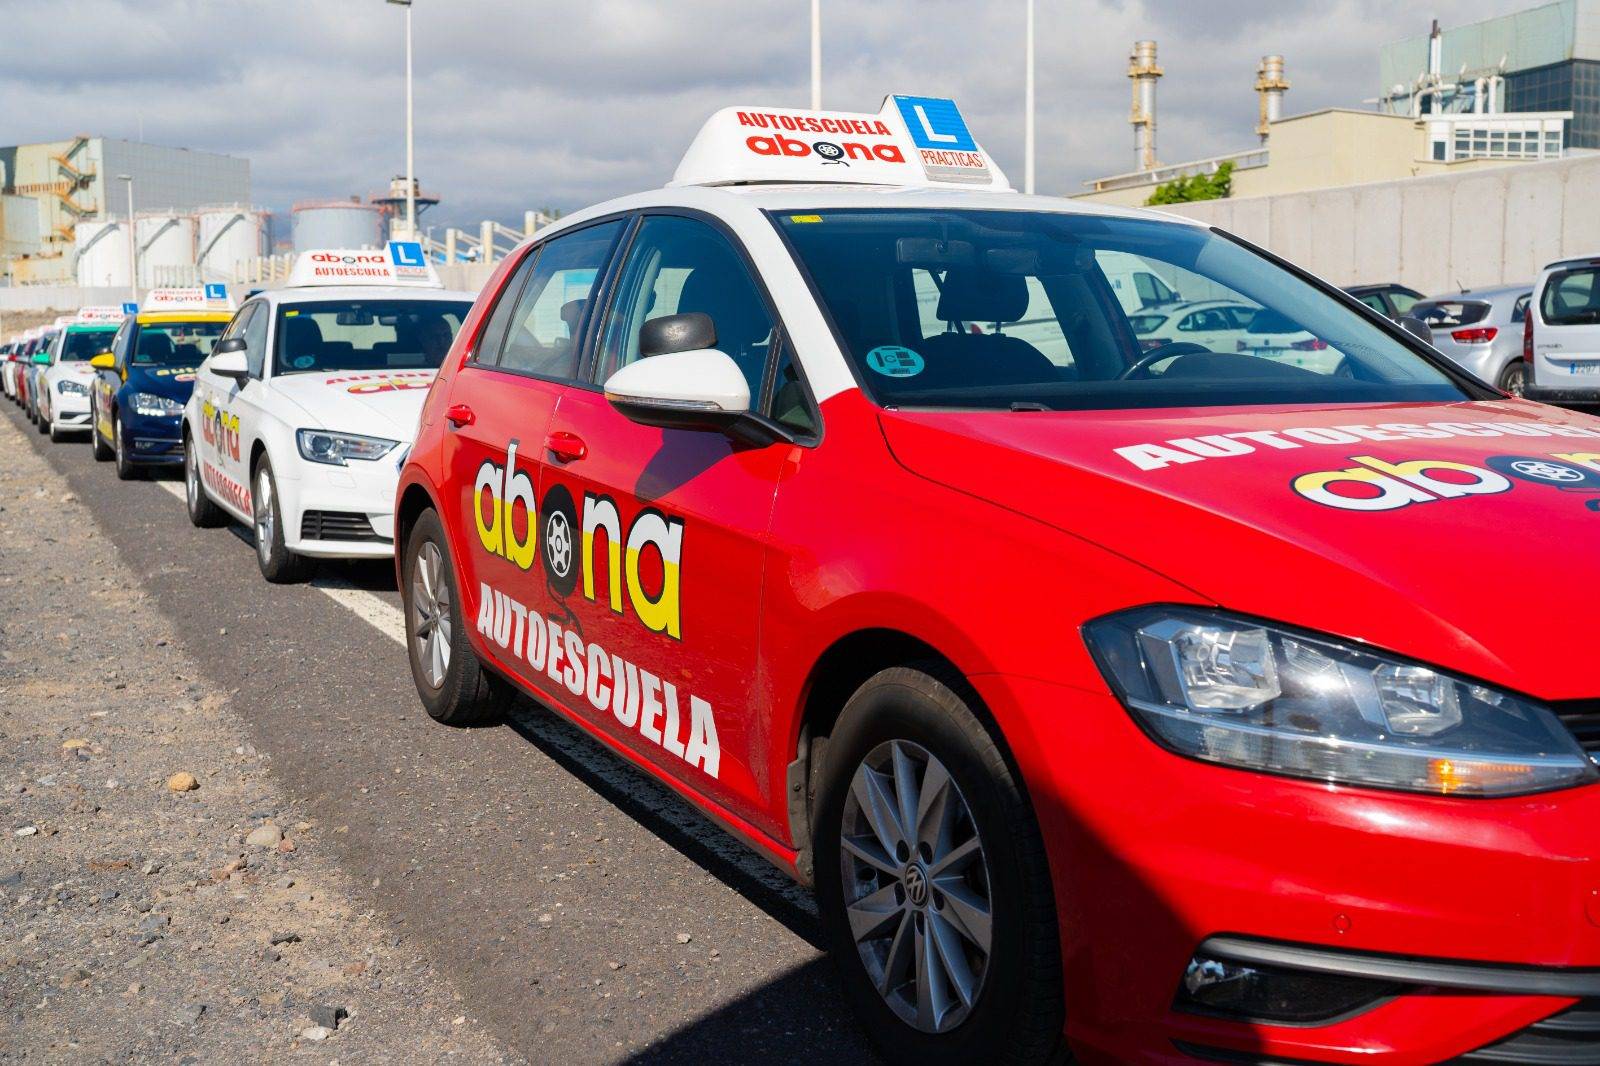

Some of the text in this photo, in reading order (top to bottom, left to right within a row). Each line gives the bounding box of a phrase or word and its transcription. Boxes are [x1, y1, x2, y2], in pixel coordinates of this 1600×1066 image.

[737, 111, 892, 136] AUTOESCUELA
[913, 105, 958, 143] L
[746, 134, 906, 167] abona
[920, 149, 983, 168] PRACTICAS
[311, 252, 385, 264] abona
[397, 245, 417, 263] L
[315, 267, 391, 277] AUTOESCUELA
[209, 285, 222, 298] L
[473, 438, 685, 642] abona
[476, 582, 721, 779] AUTOESCUELA
